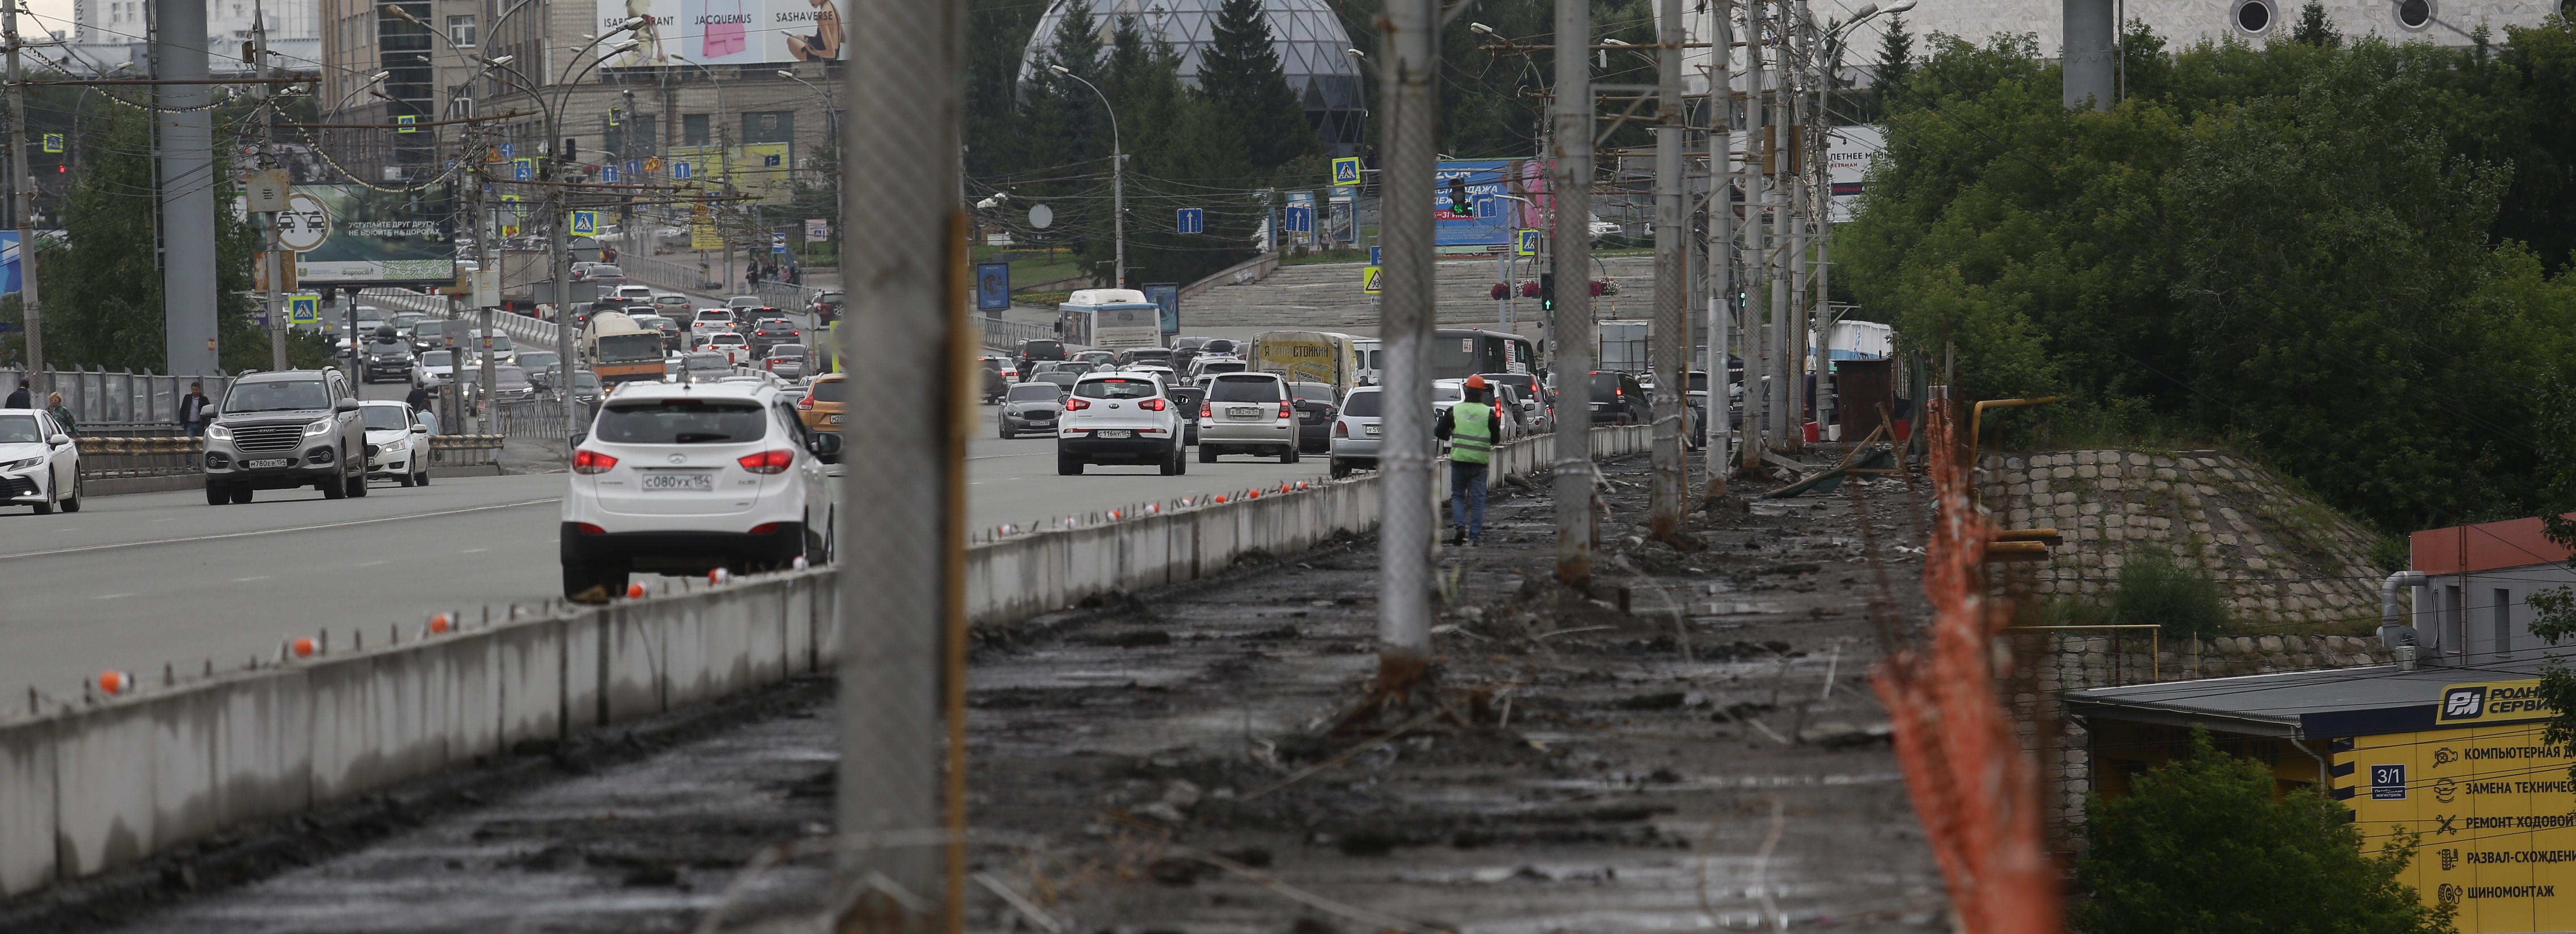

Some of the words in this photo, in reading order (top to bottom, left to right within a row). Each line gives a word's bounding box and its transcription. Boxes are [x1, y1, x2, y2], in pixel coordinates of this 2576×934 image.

[652, 17, 674, 25] RANT
[694, 14, 752, 25] JACQUEMUS
[776, 11, 833, 22] SASHAVERSE
[1830, 152, 1863, 161] ЛЕТНЕЕ
[1434, 168, 1471, 179] ZON
[2490, 686, 2540, 700] РОДН
[2489, 697, 2548, 714] СЕРВИ
[2464, 746, 2560, 760] КОМПЬЮТЕРНАЯ
[2377, 768, 2399, 783] 3/1
[2465, 782, 2512, 795] ЗАМЕНА
[2466, 816, 2513, 829] РЕМОНТ
[2467, 885, 2555, 899] ШИНОМОНТАЖ
